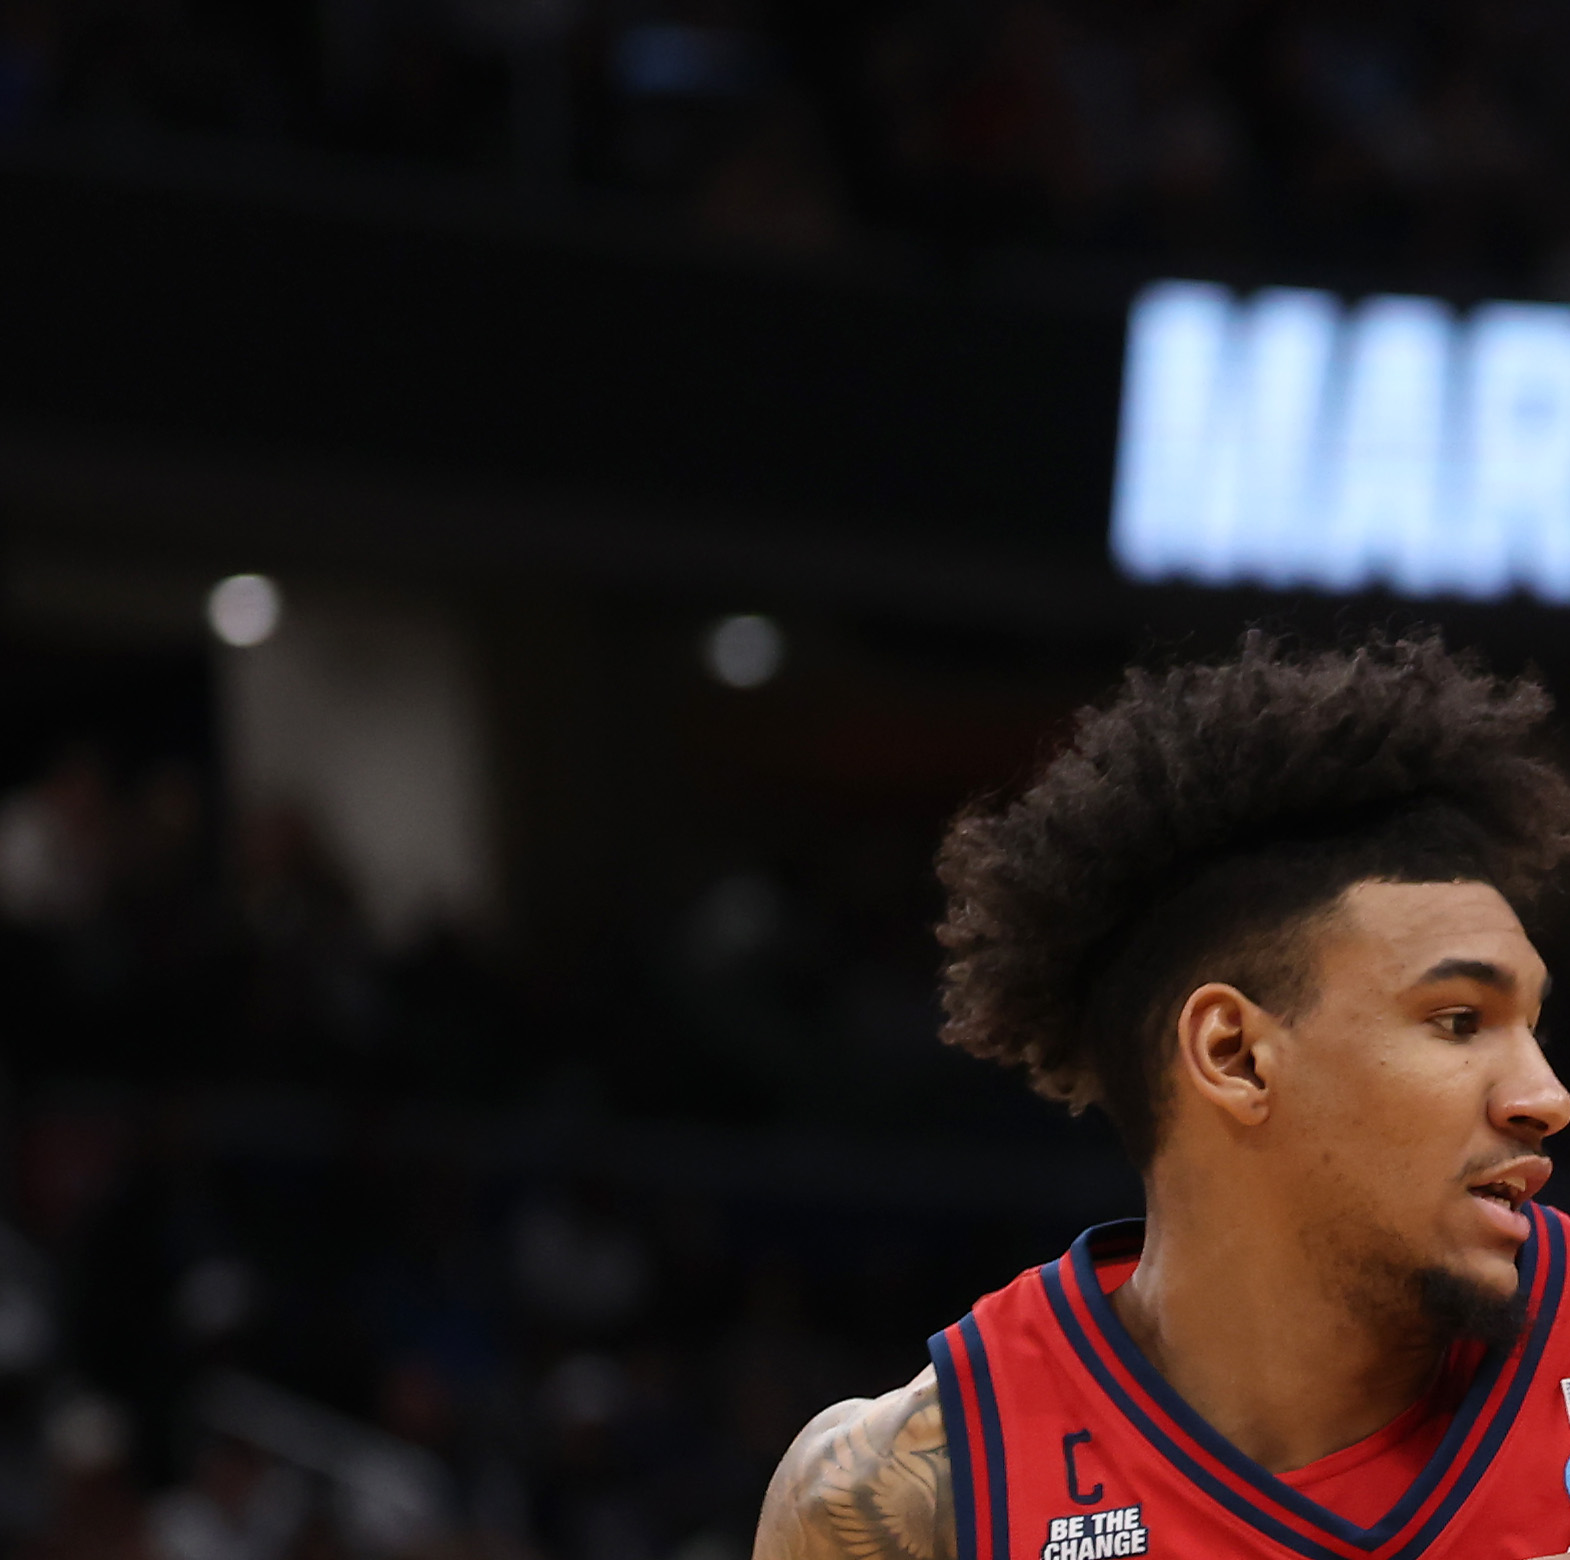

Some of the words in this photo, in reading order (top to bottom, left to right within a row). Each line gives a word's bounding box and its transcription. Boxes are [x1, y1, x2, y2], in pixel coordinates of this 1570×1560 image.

[1062, 1428, 1104, 1506] C
[1050, 1516, 1085, 1543] BE
[1091, 1507, 1140, 1536] THE
